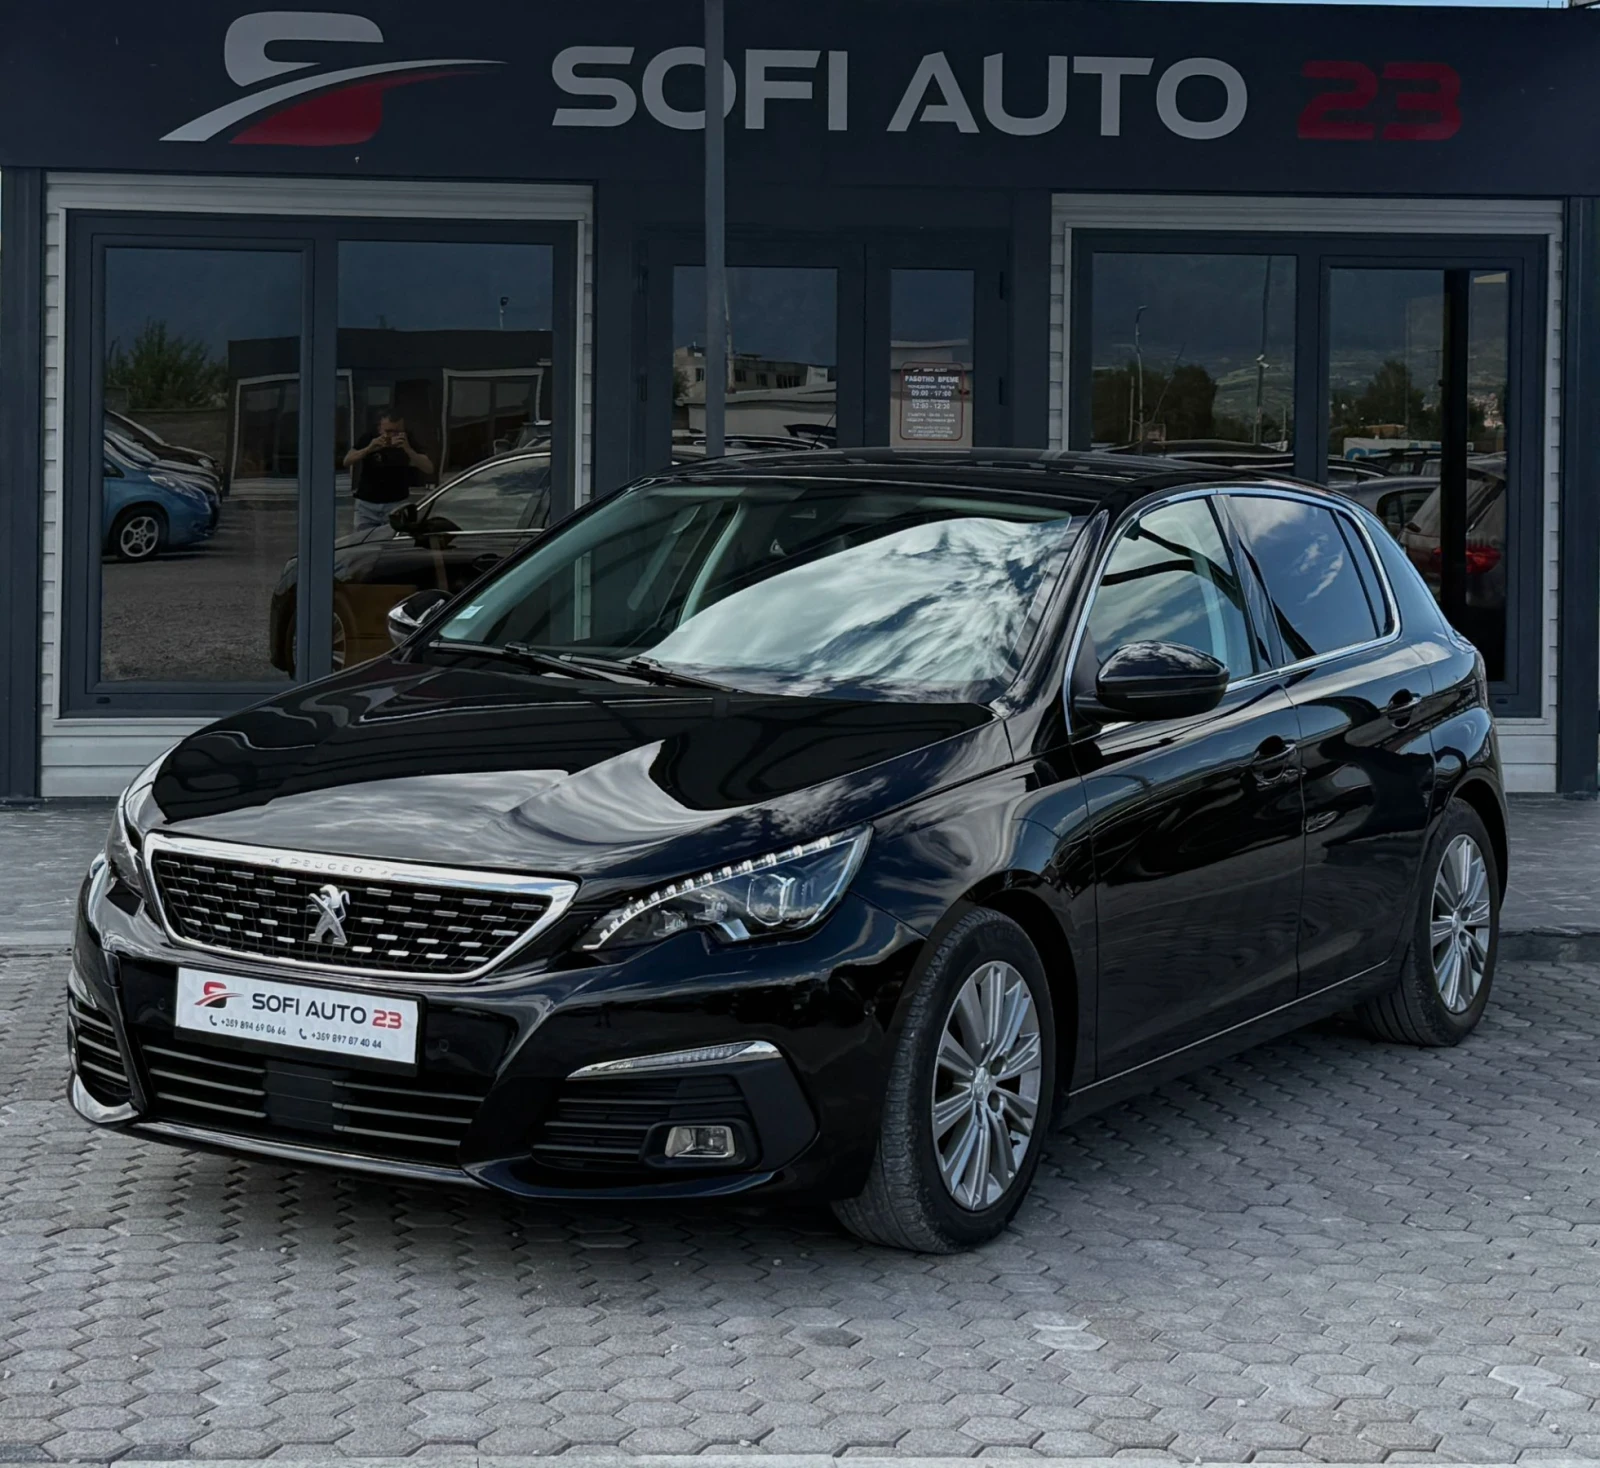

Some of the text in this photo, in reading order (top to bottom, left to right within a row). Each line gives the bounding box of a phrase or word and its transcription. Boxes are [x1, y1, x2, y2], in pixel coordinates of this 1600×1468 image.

[552, 46, 1462, 141] SOFI AUTO 23
[905, 375, 935, 383] РАБОТНО
[290, 858, 376, 874] PEUGEOT
[252, 993, 403, 1029] SOFI AUTO 23
[221, 1017, 287, 1036] +359 894 69 06 66
[311, 1031, 382, 1049] +359 897 87 40 44
